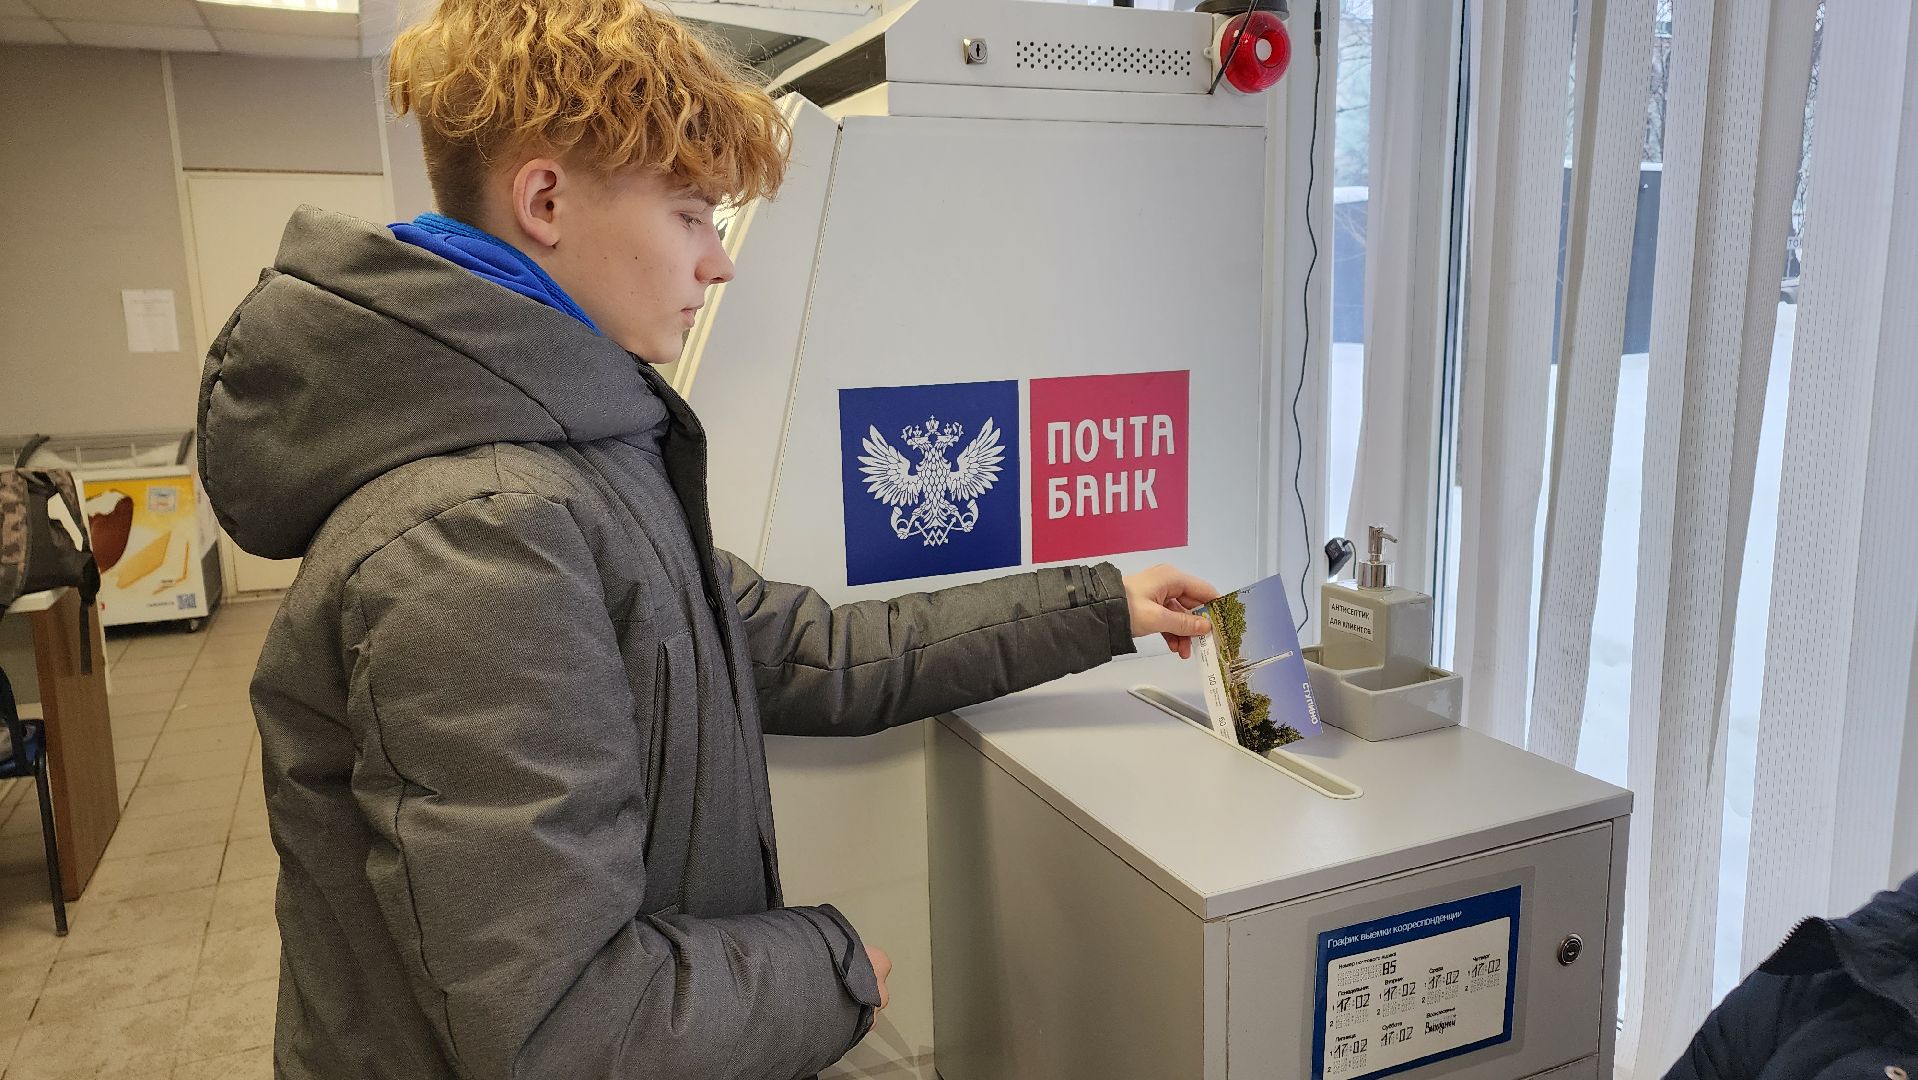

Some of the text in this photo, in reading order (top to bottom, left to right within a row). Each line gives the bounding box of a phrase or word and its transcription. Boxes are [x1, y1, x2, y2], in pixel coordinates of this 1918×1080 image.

[1048, 414, 1175, 465] ПОЧТА
[1048, 468, 1159, 520] БАНК
[1330, 617, 1372, 635] ДЛЯ КЛИЕНТОВ
[1331, 603, 1370, 620] АНТИСЕПТИК
[1302, 682, 1319, 725] СТУПИНО
[1327, 910, 1463, 949] График выемки корреспонденции
